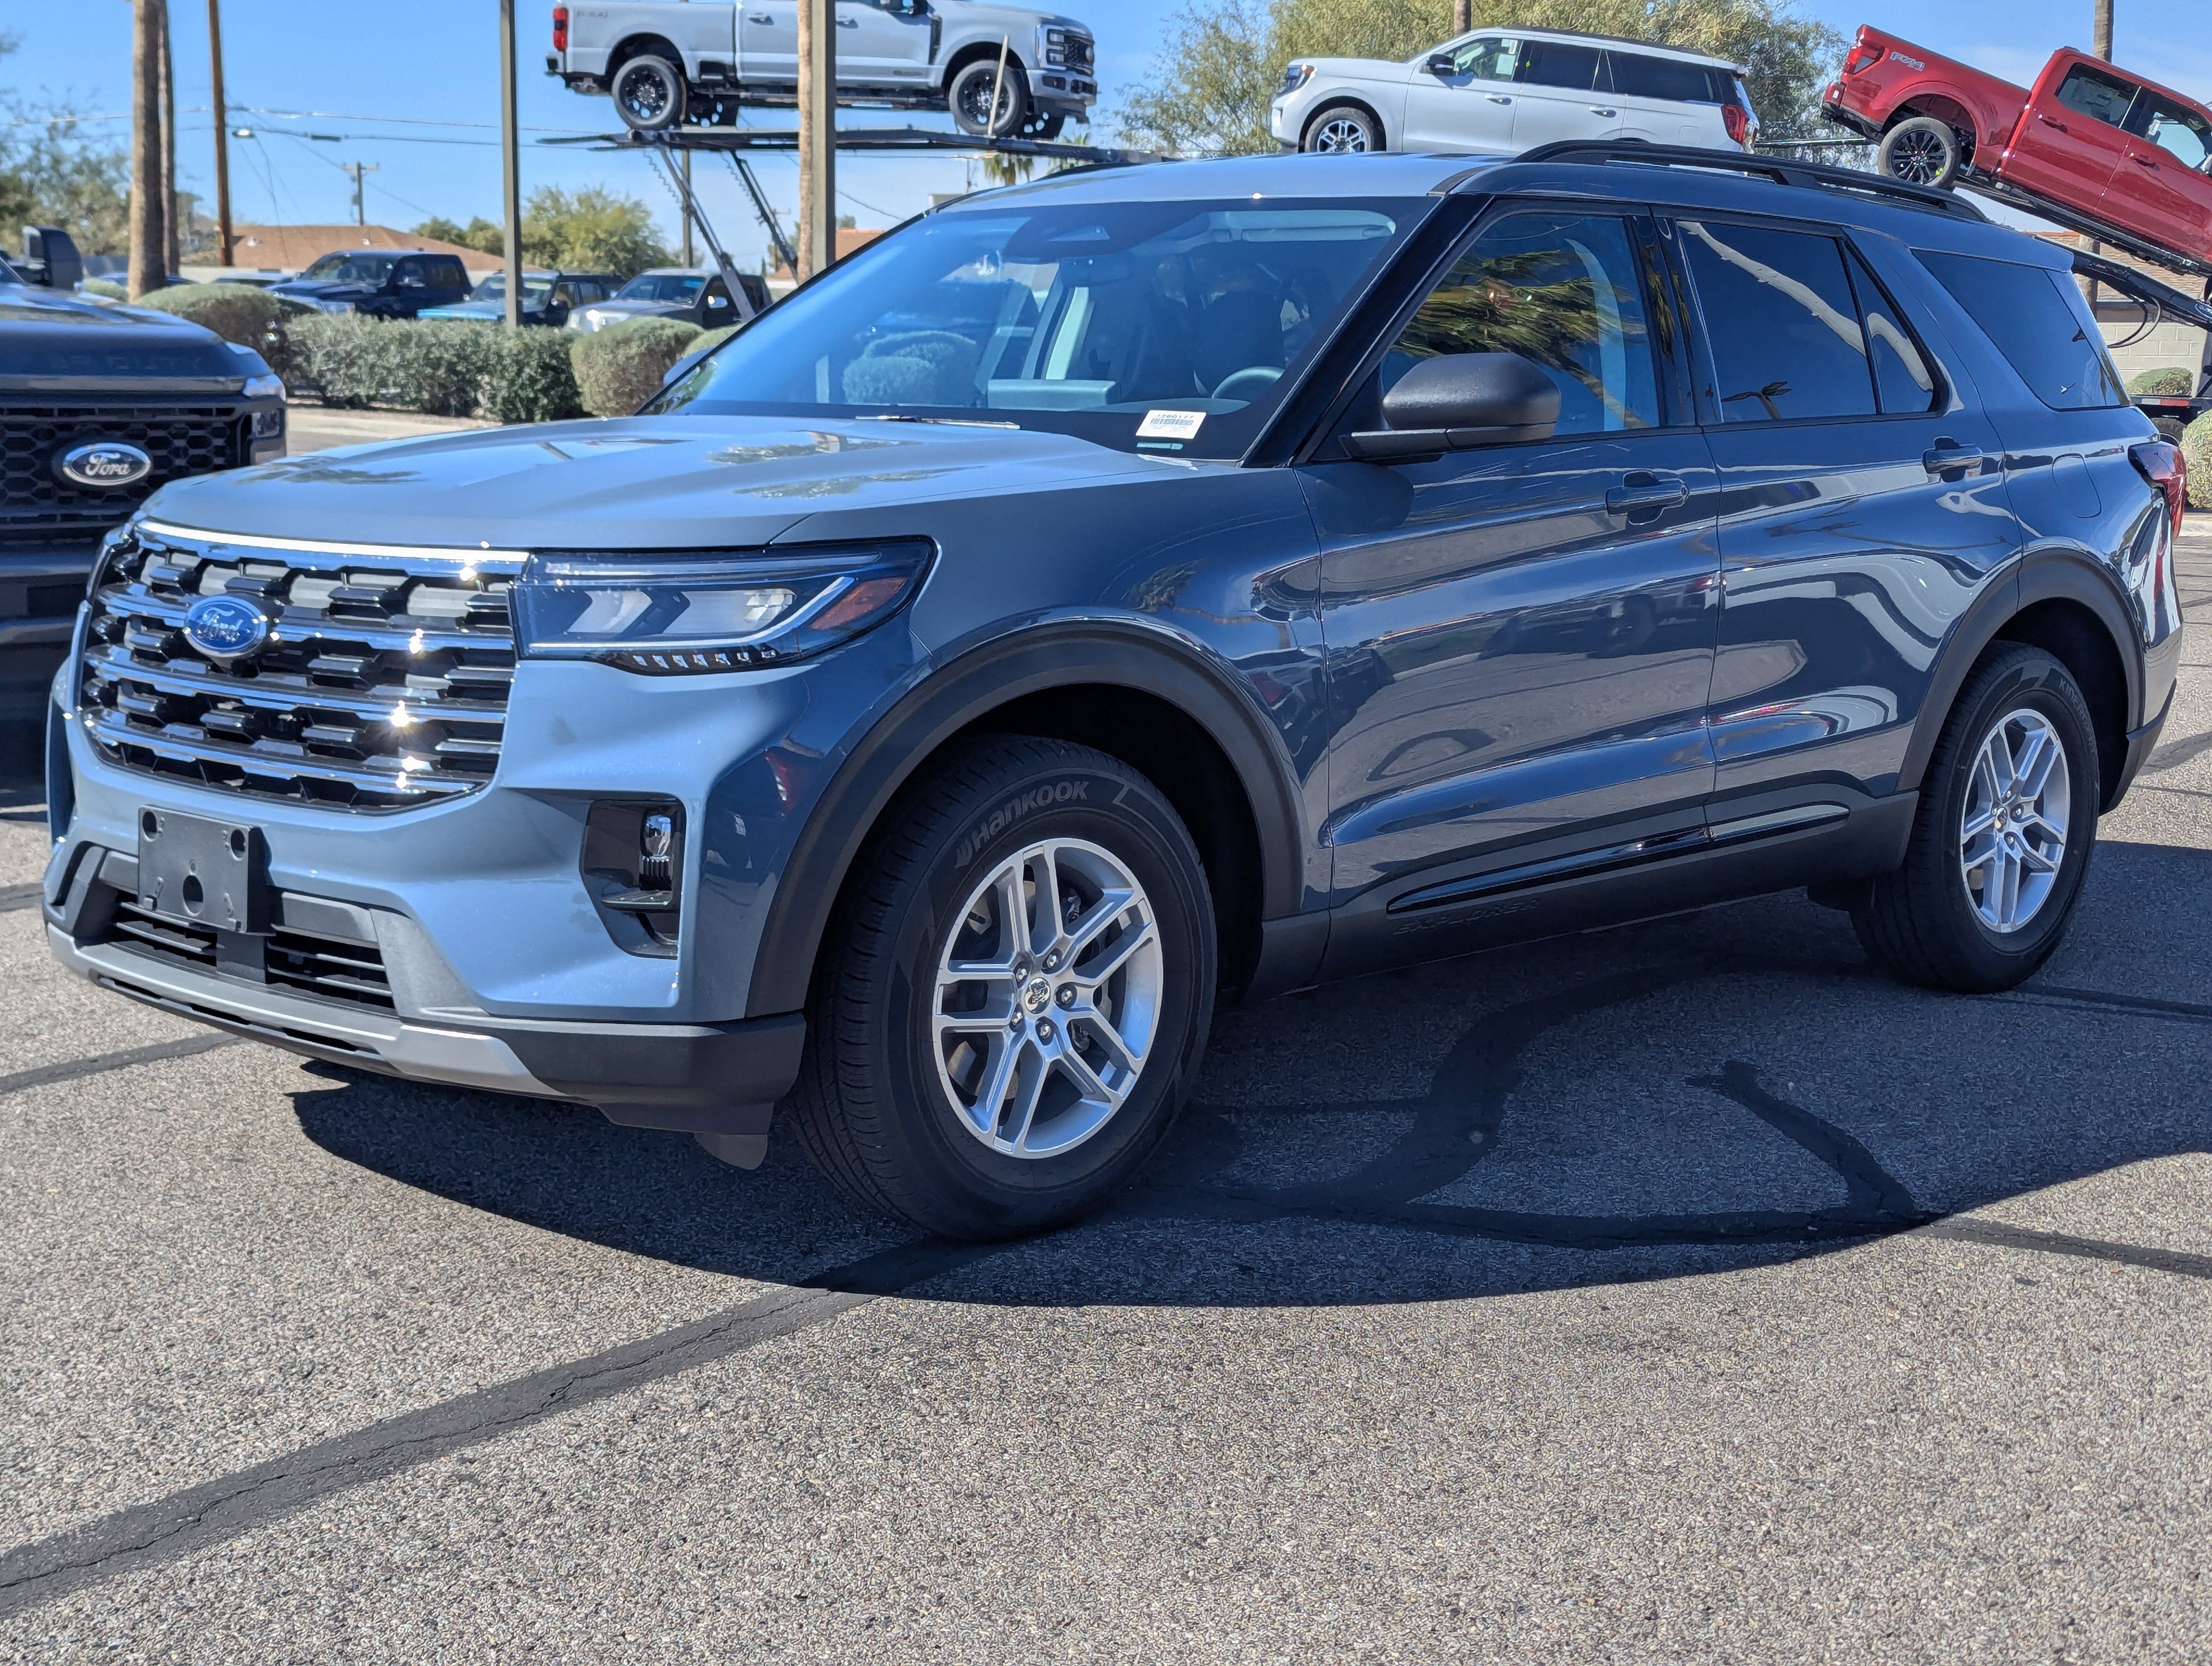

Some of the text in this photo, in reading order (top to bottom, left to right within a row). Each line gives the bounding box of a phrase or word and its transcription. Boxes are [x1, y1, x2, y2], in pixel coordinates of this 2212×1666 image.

[85, 452, 131, 476] Ford
[196, 607, 244, 643] Ford
[1392, 899, 1539, 937] EXPLORER
